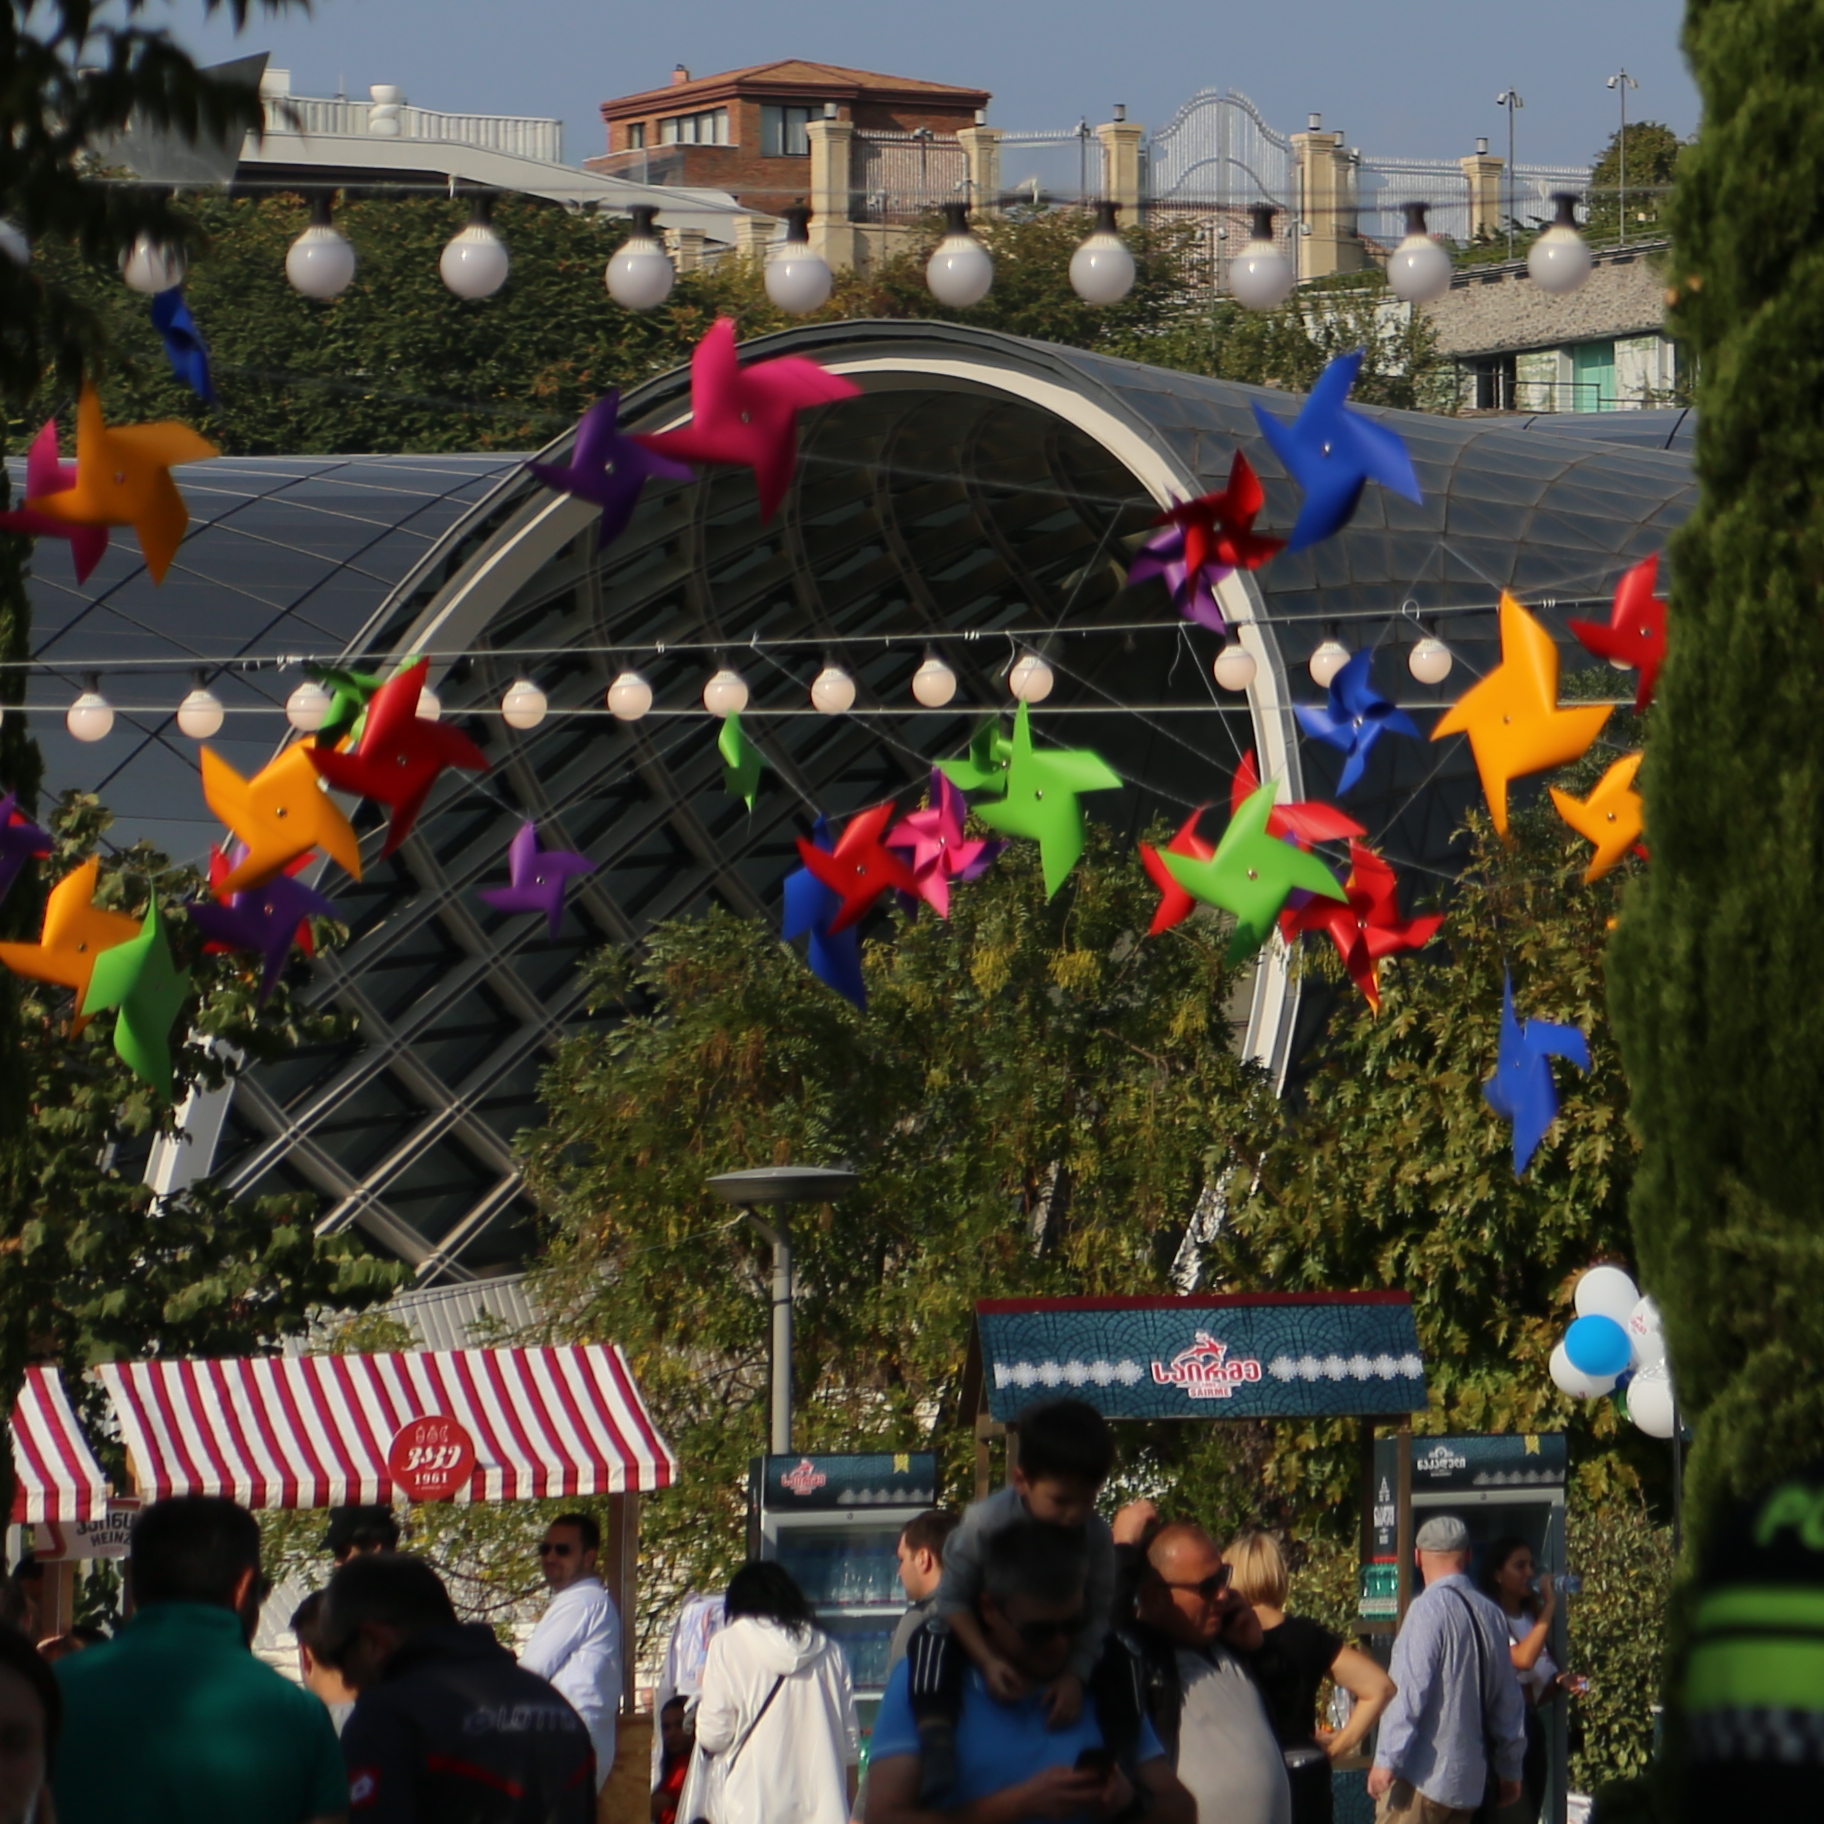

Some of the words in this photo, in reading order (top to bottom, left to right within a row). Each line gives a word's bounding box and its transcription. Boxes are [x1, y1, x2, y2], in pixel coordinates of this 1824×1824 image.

[1151, 1360, 1262, 1384] საირმე
[1190, 1387, 1230, 1397] SAIRME
[415, 1471, 448, 1485] 1961
